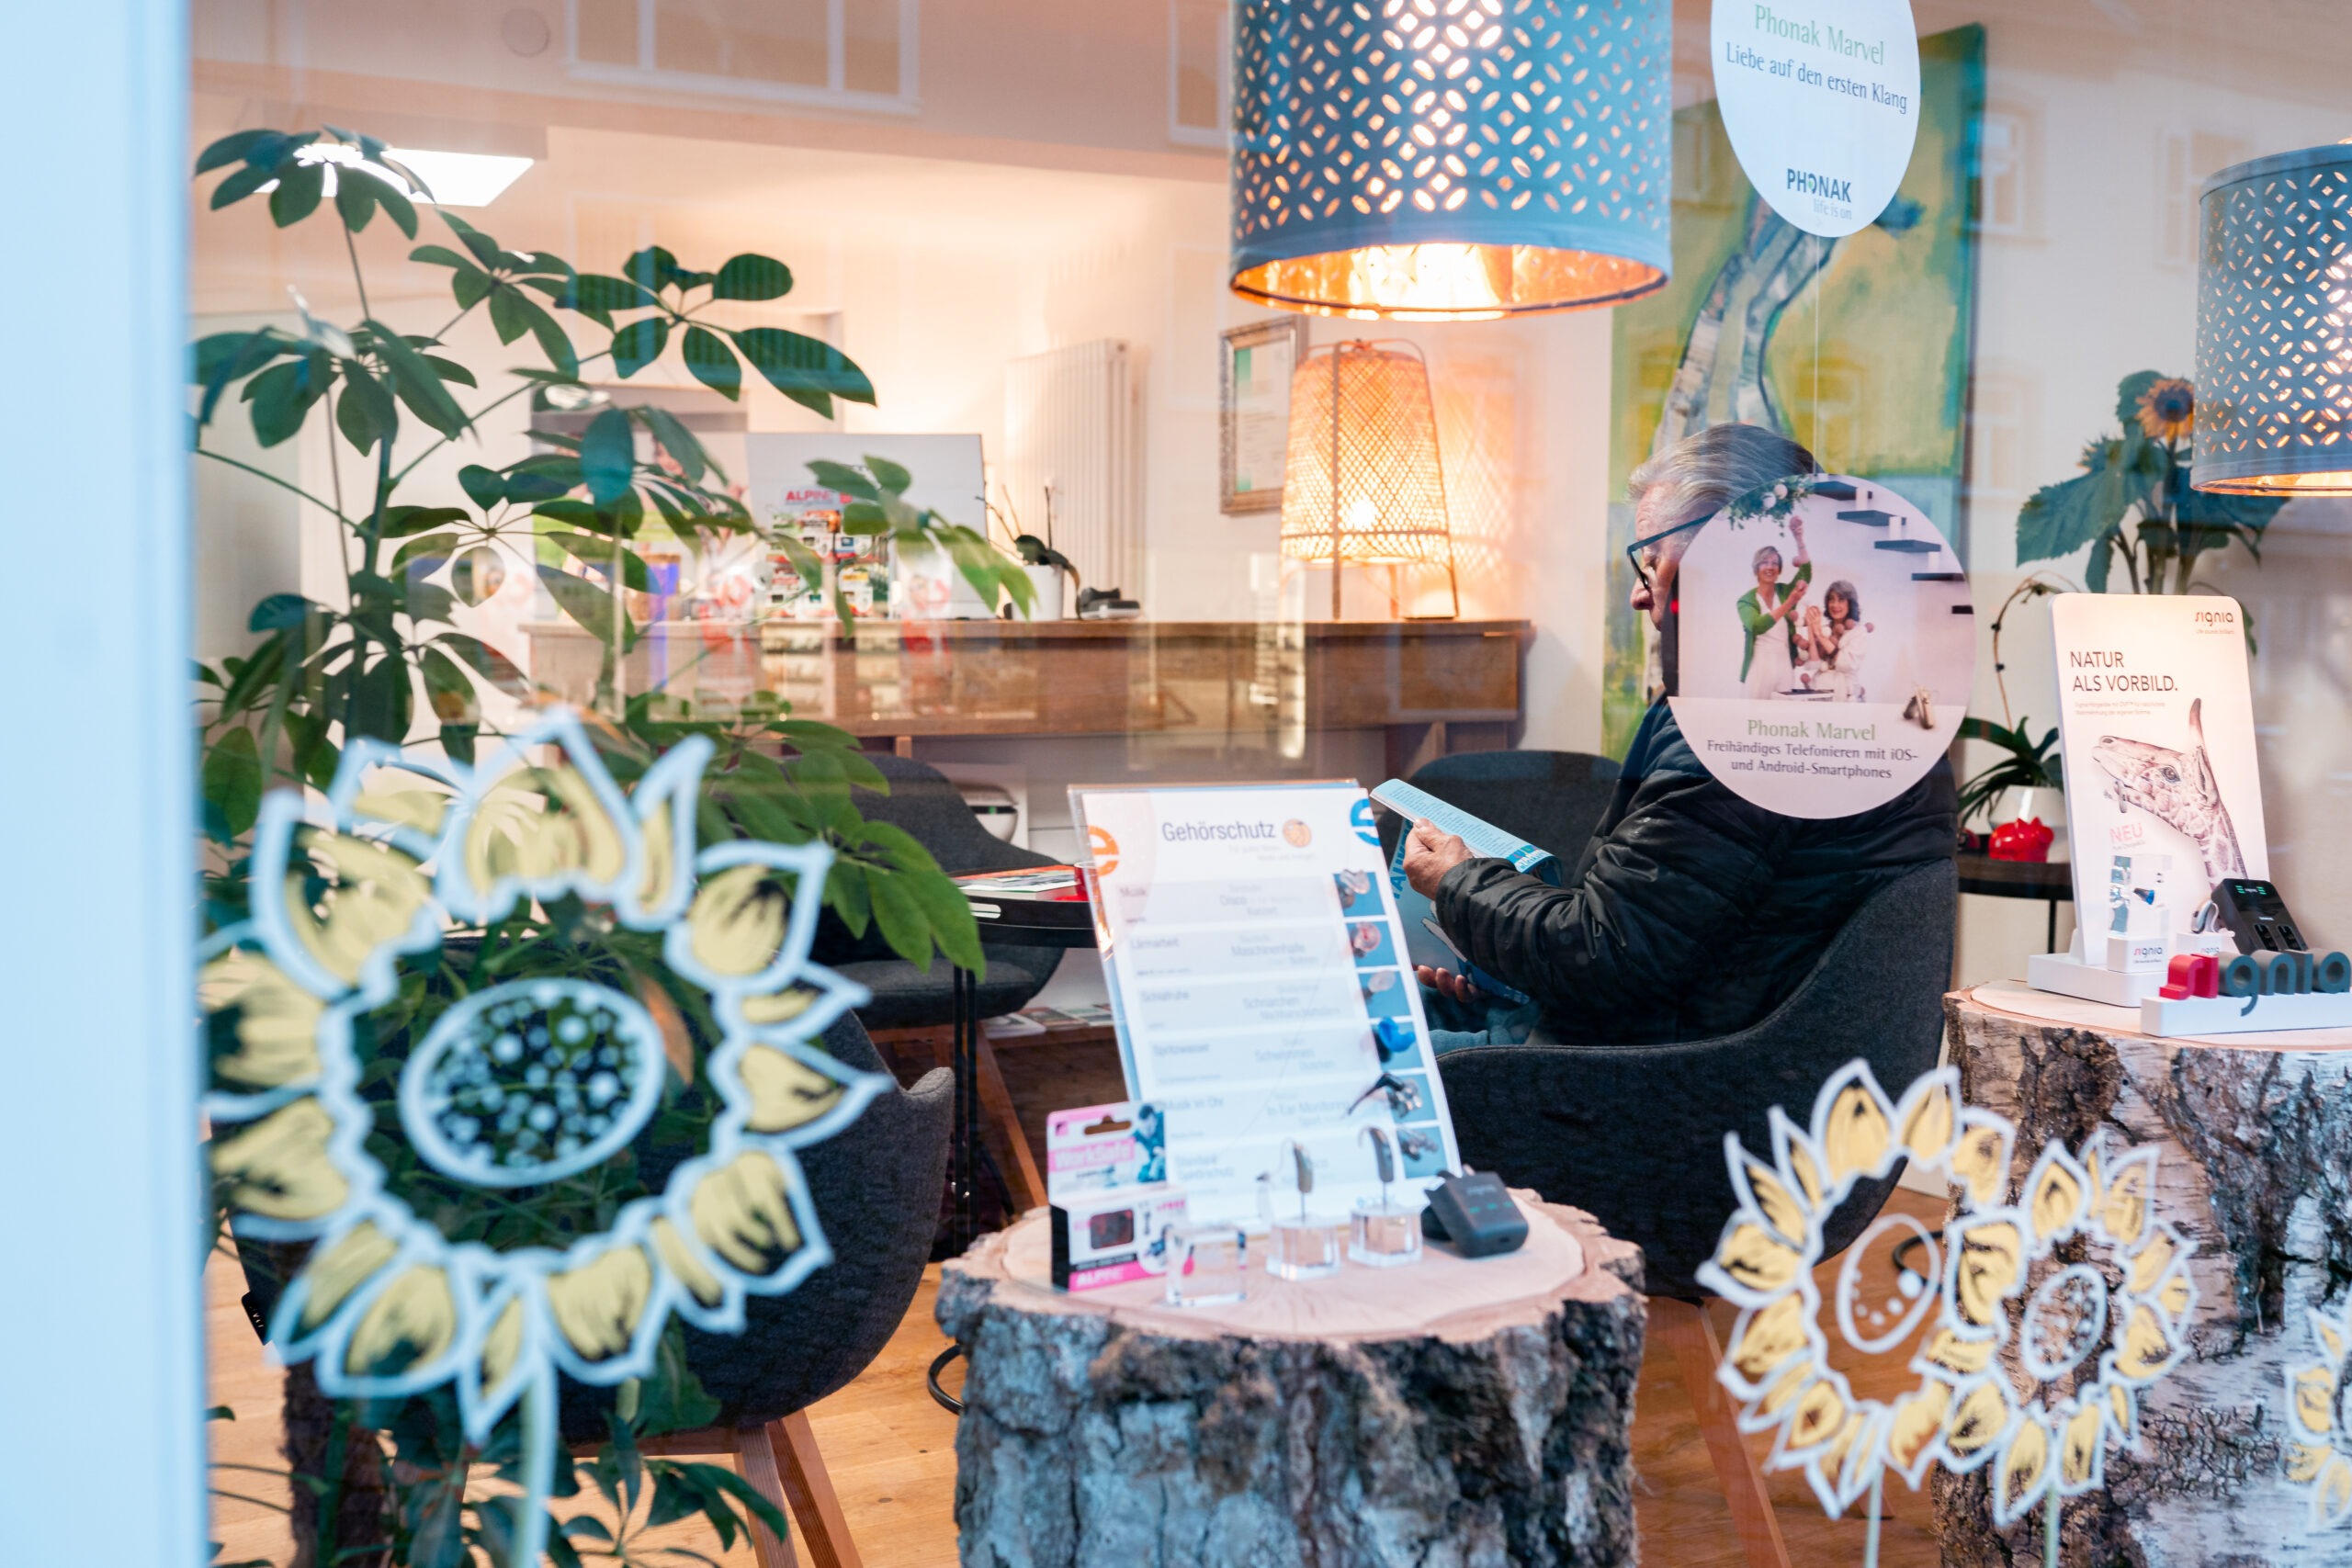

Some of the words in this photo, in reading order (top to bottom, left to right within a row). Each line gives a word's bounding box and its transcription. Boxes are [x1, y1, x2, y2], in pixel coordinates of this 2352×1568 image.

[1755, 5, 1821, 47] Phonak
[1827, 26, 1883, 65] Marvel
[1726, 41, 1765, 71] Liebe
[1770, 59, 1794, 78] auf
[1797, 62, 1822, 86] den
[1827, 74, 1867, 99] ersten
[1871, 83, 1907, 115] Klang
[1787, 168, 1852, 202] PHONAK
[2195, 611, 2233, 626] signia
[2070, 651, 2124, 668] NATUR
[2073, 675, 2102, 692] ALS
[2106, 675, 2178, 692] VORBILD.
[1747, 719, 1809, 739] Phonak
[1816, 722, 1875, 741] Marvel
[1707, 739, 1781, 757] Freihändiges
[1785, 743, 1860, 759] Telefonieren
[1864, 748, 1885, 761] mit
[1891, 749, 1918, 761] iOS-
[1731, 760, 1753, 772] und
[1758, 761, 1892, 780] Android-Smartphones
[1161, 820, 1278, 842] Gehörschutz
[2110, 823, 2143, 843] NEU
[2159, 950, 2351, 1017] signia
